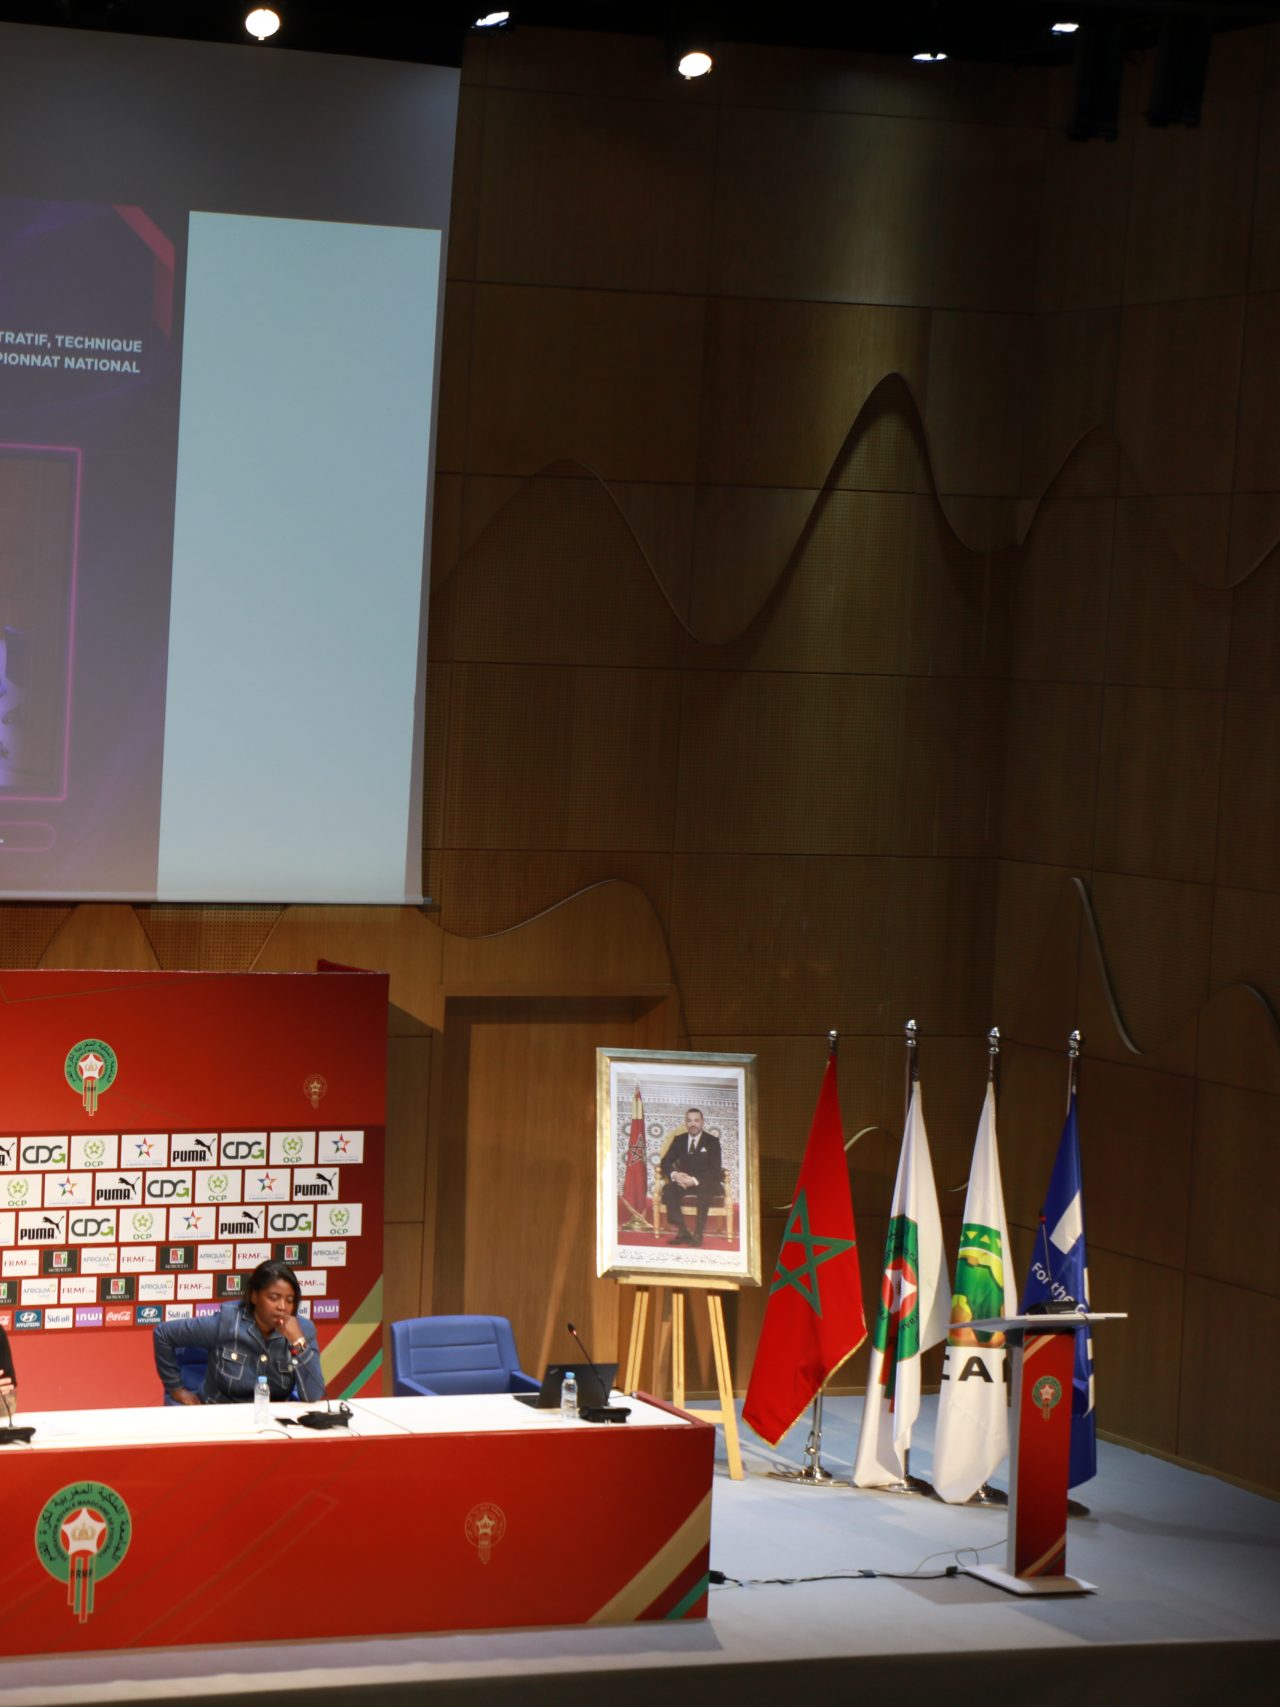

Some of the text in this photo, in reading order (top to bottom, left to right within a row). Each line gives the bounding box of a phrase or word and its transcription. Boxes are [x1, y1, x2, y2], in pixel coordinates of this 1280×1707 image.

[56, 336, 142, 353] TECHNIQUE
[64, 358, 140, 373] NATIONAL
[172, 1150, 206, 1162] PUMA
[96, 1188, 130, 1201] PUMA
[294, 1184, 327, 1196] PUMA
[20, 1228, 55, 1240] PUMA
[220, 1222, 254, 1234] PUMA
[15, 1320, 41, 1328] HYUNDAI
